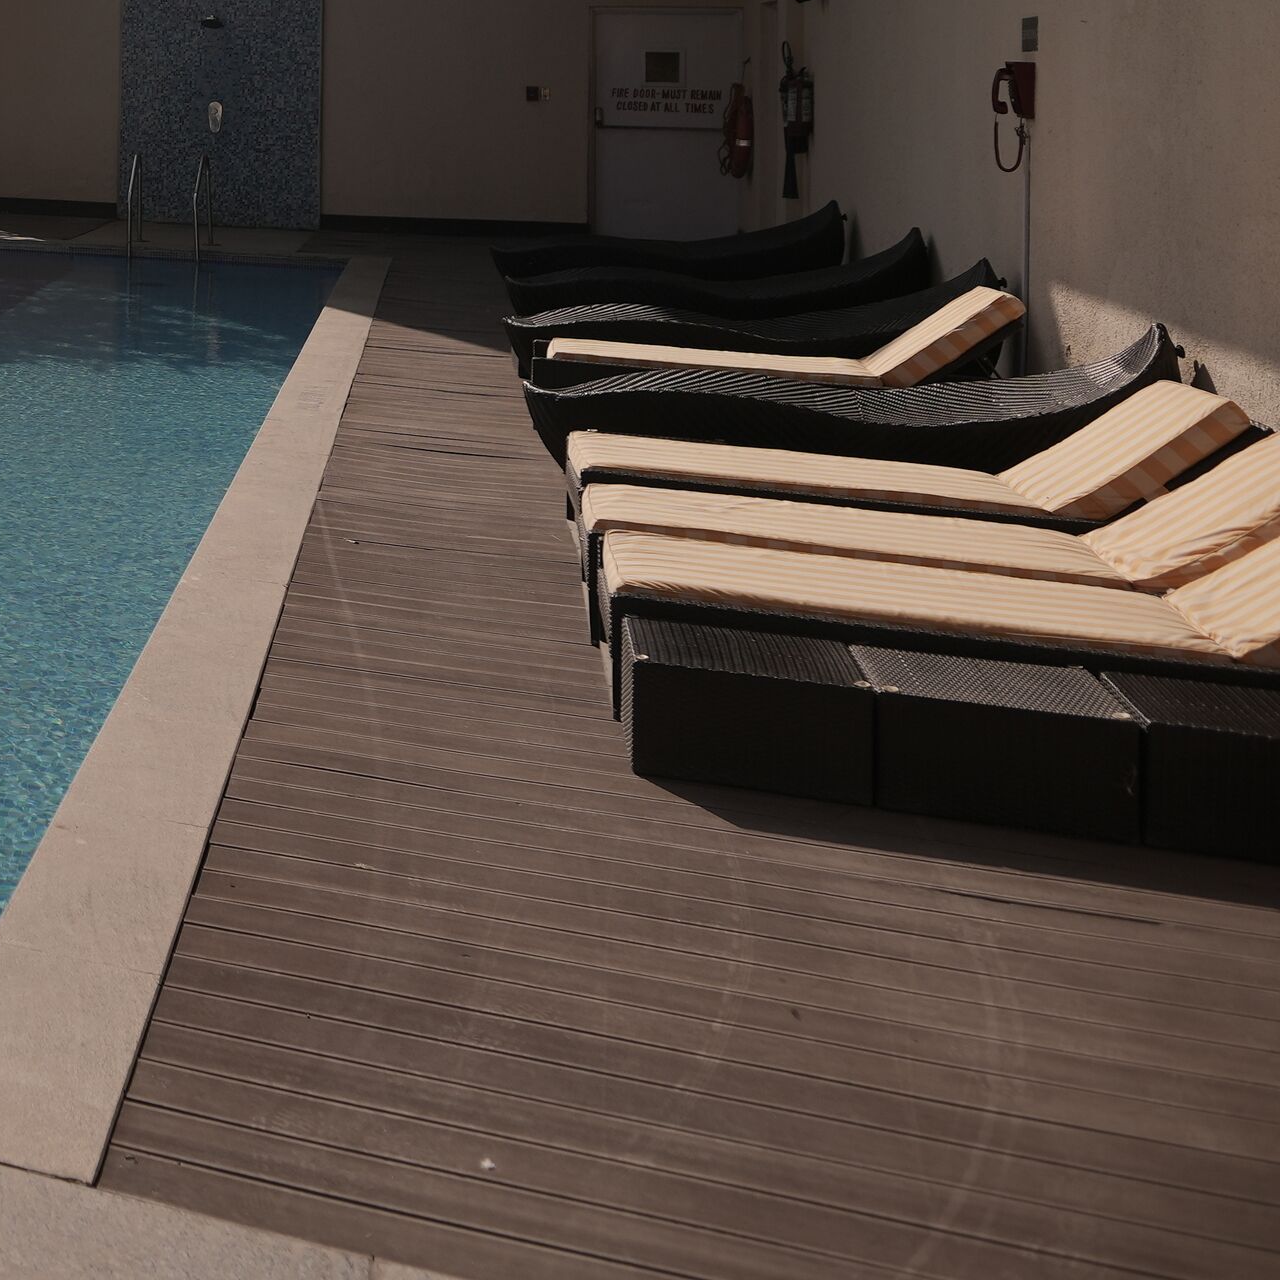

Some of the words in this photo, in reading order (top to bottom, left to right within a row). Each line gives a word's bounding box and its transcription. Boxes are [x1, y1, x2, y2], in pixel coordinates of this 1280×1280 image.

[611, 87, 630, 98] FIRE
[690, 89, 722, 101] REMAIN
[616, 101, 648, 112] CLOSED
[650, 102, 661, 113] AT
[663, 102, 680, 113] ALL
[684, 103, 714, 114] TIMES
